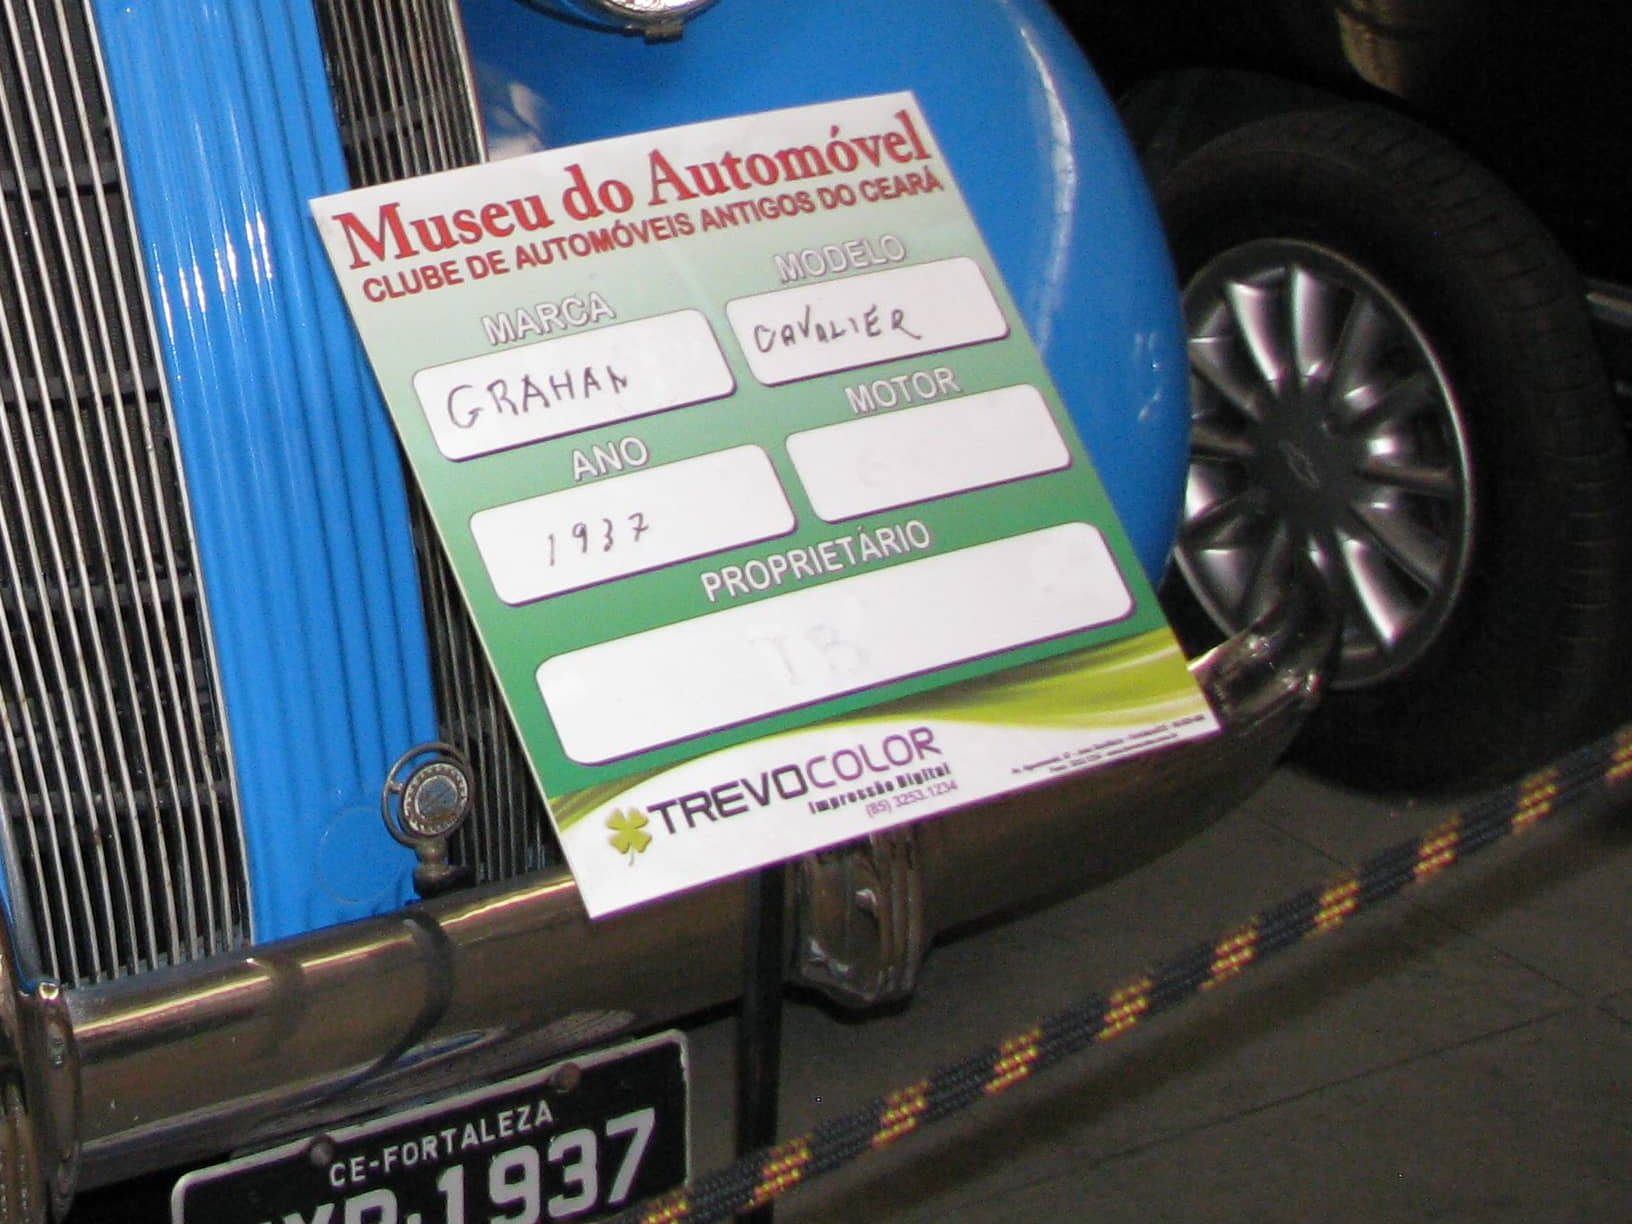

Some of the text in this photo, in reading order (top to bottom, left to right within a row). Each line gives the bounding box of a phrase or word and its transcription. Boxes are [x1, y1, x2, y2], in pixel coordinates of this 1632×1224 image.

[332, 109, 931, 270] Museu do Automóvel
[363, 166, 945, 302] CLUBE DE AUTOMÓVEIS ANTIGOS DO CEARÁ
[773, 234, 907, 284] MODELO
[482, 291, 615, 346] MARCA
[844, 367, 962, 414] MOTOR
[571, 436, 650, 482] ANO
[547, 512, 649, 567] 1937
[700, 520, 933, 603] PROPRIETÁRIO
[647, 726, 942, 834] TREVOCOLOR
[330, 1099, 554, 1187] CE-FORTALEZA
